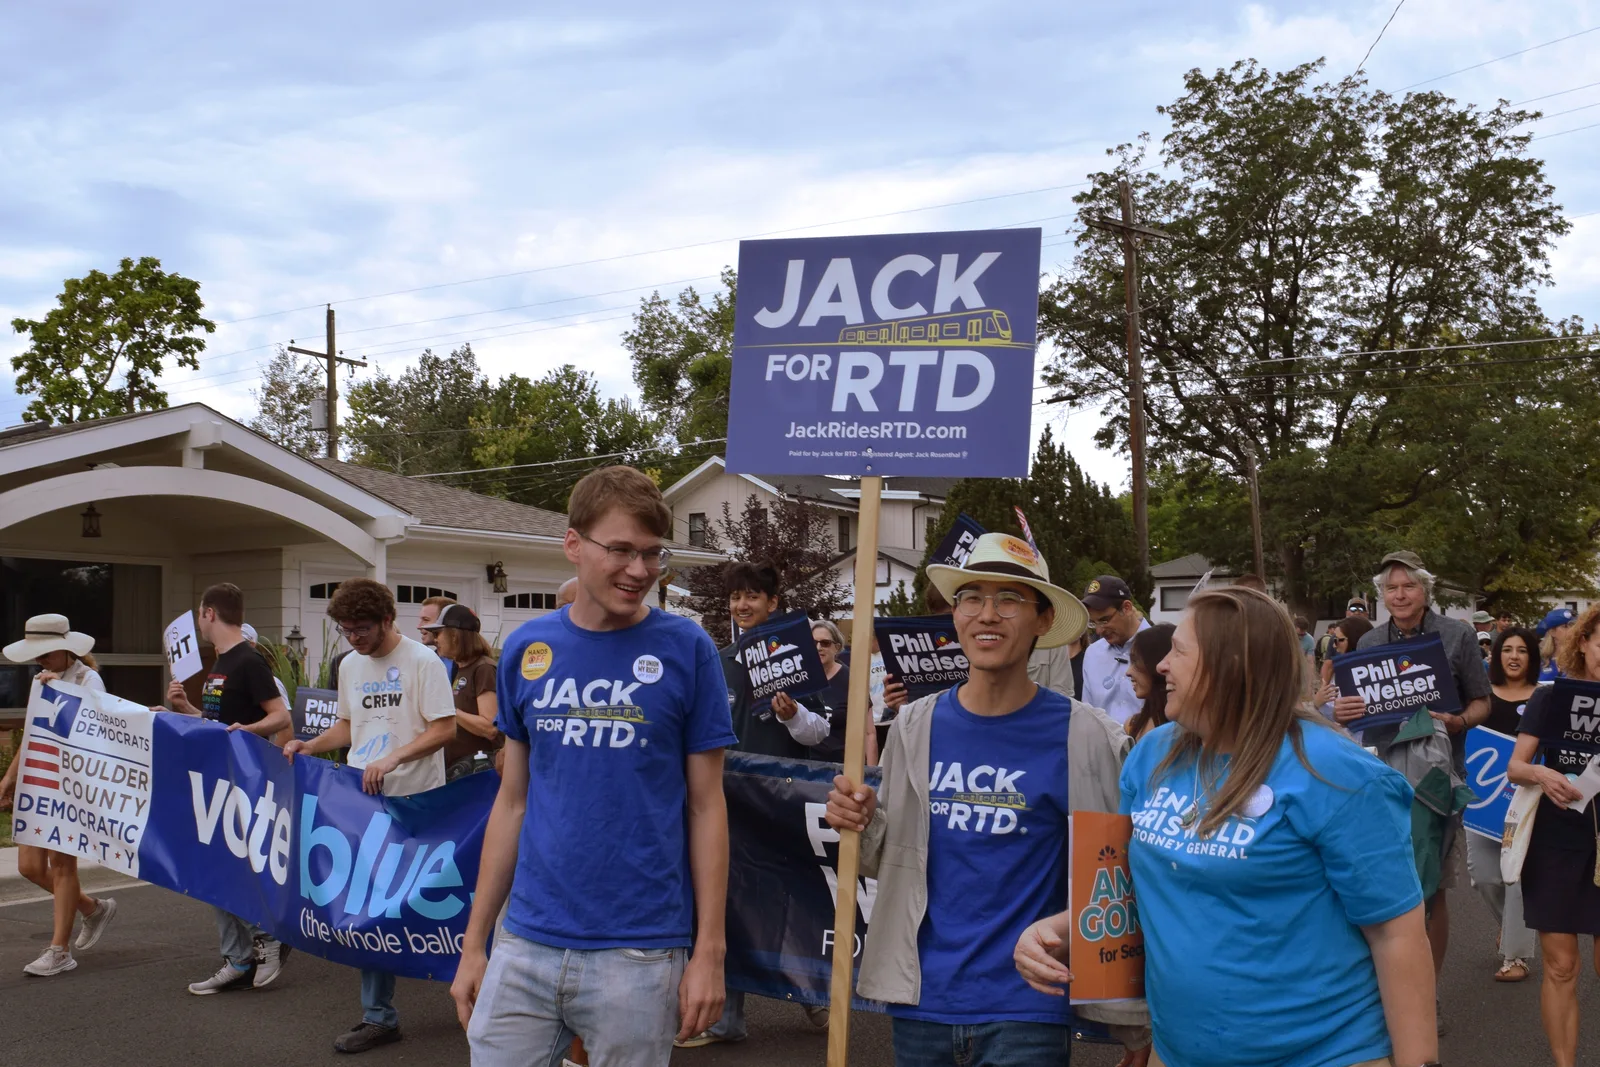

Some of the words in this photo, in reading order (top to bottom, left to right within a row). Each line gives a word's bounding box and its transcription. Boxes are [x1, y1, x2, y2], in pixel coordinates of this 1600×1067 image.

[753, 252, 1003, 328] JACK
[765, 354, 832, 381] FOR
[831, 350, 995, 412] RTD
[785, 422, 967, 439] JackRidesRTD.com
[745, 639, 769, 668] Phil
[889, 632, 935, 654] Phil
[748, 653, 804, 688] Weiser
[753, 687, 764, 699] FOR
[763, 670, 809, 695] GOVERNOR
[901, 674, 925, 684] FOR
[1351, 659, 1397, 686] Phil
[362, 680, 402, 693] GOOSE
[532, 678, 642, 709] JACK
[1356, 674, 1437, 705] Weiser
[305, 698, 338, 714] Phil
[362, 694, 402, 709] CREW
[1365, 703, 1384, 715] OR
[1384, 690, 1441, 710] GOVERNOR
[81, 708, 127, 729] COLORADO
[301, 726, 317, 734] FOR
[75, 720, 150, 752] DEMOCRATS
[536, 719, 564, 732] FOR
[562, 719, 635, 748] RTD
[1563, 731, 1591, 742] FOR
[61, 750, 148, 791] BOULDER
[1558, 755, 1577, 765] FOR
[929, 761, 1027, 793] JACK
[62, 776, 147, 817] COUNTY
[17, 793, 139, 844] DEMOCRATIC
[188, 770, 291, 885] vote
[929, 801, 950, 816] OR
[947, 802, 1018, 835] RTD
[1186, 842, 1248, 859] GENERAL
[300, 907, 331, 943] (the
[332, 922, 402, 953] whole
[1099, 947, 1118, 964] for
